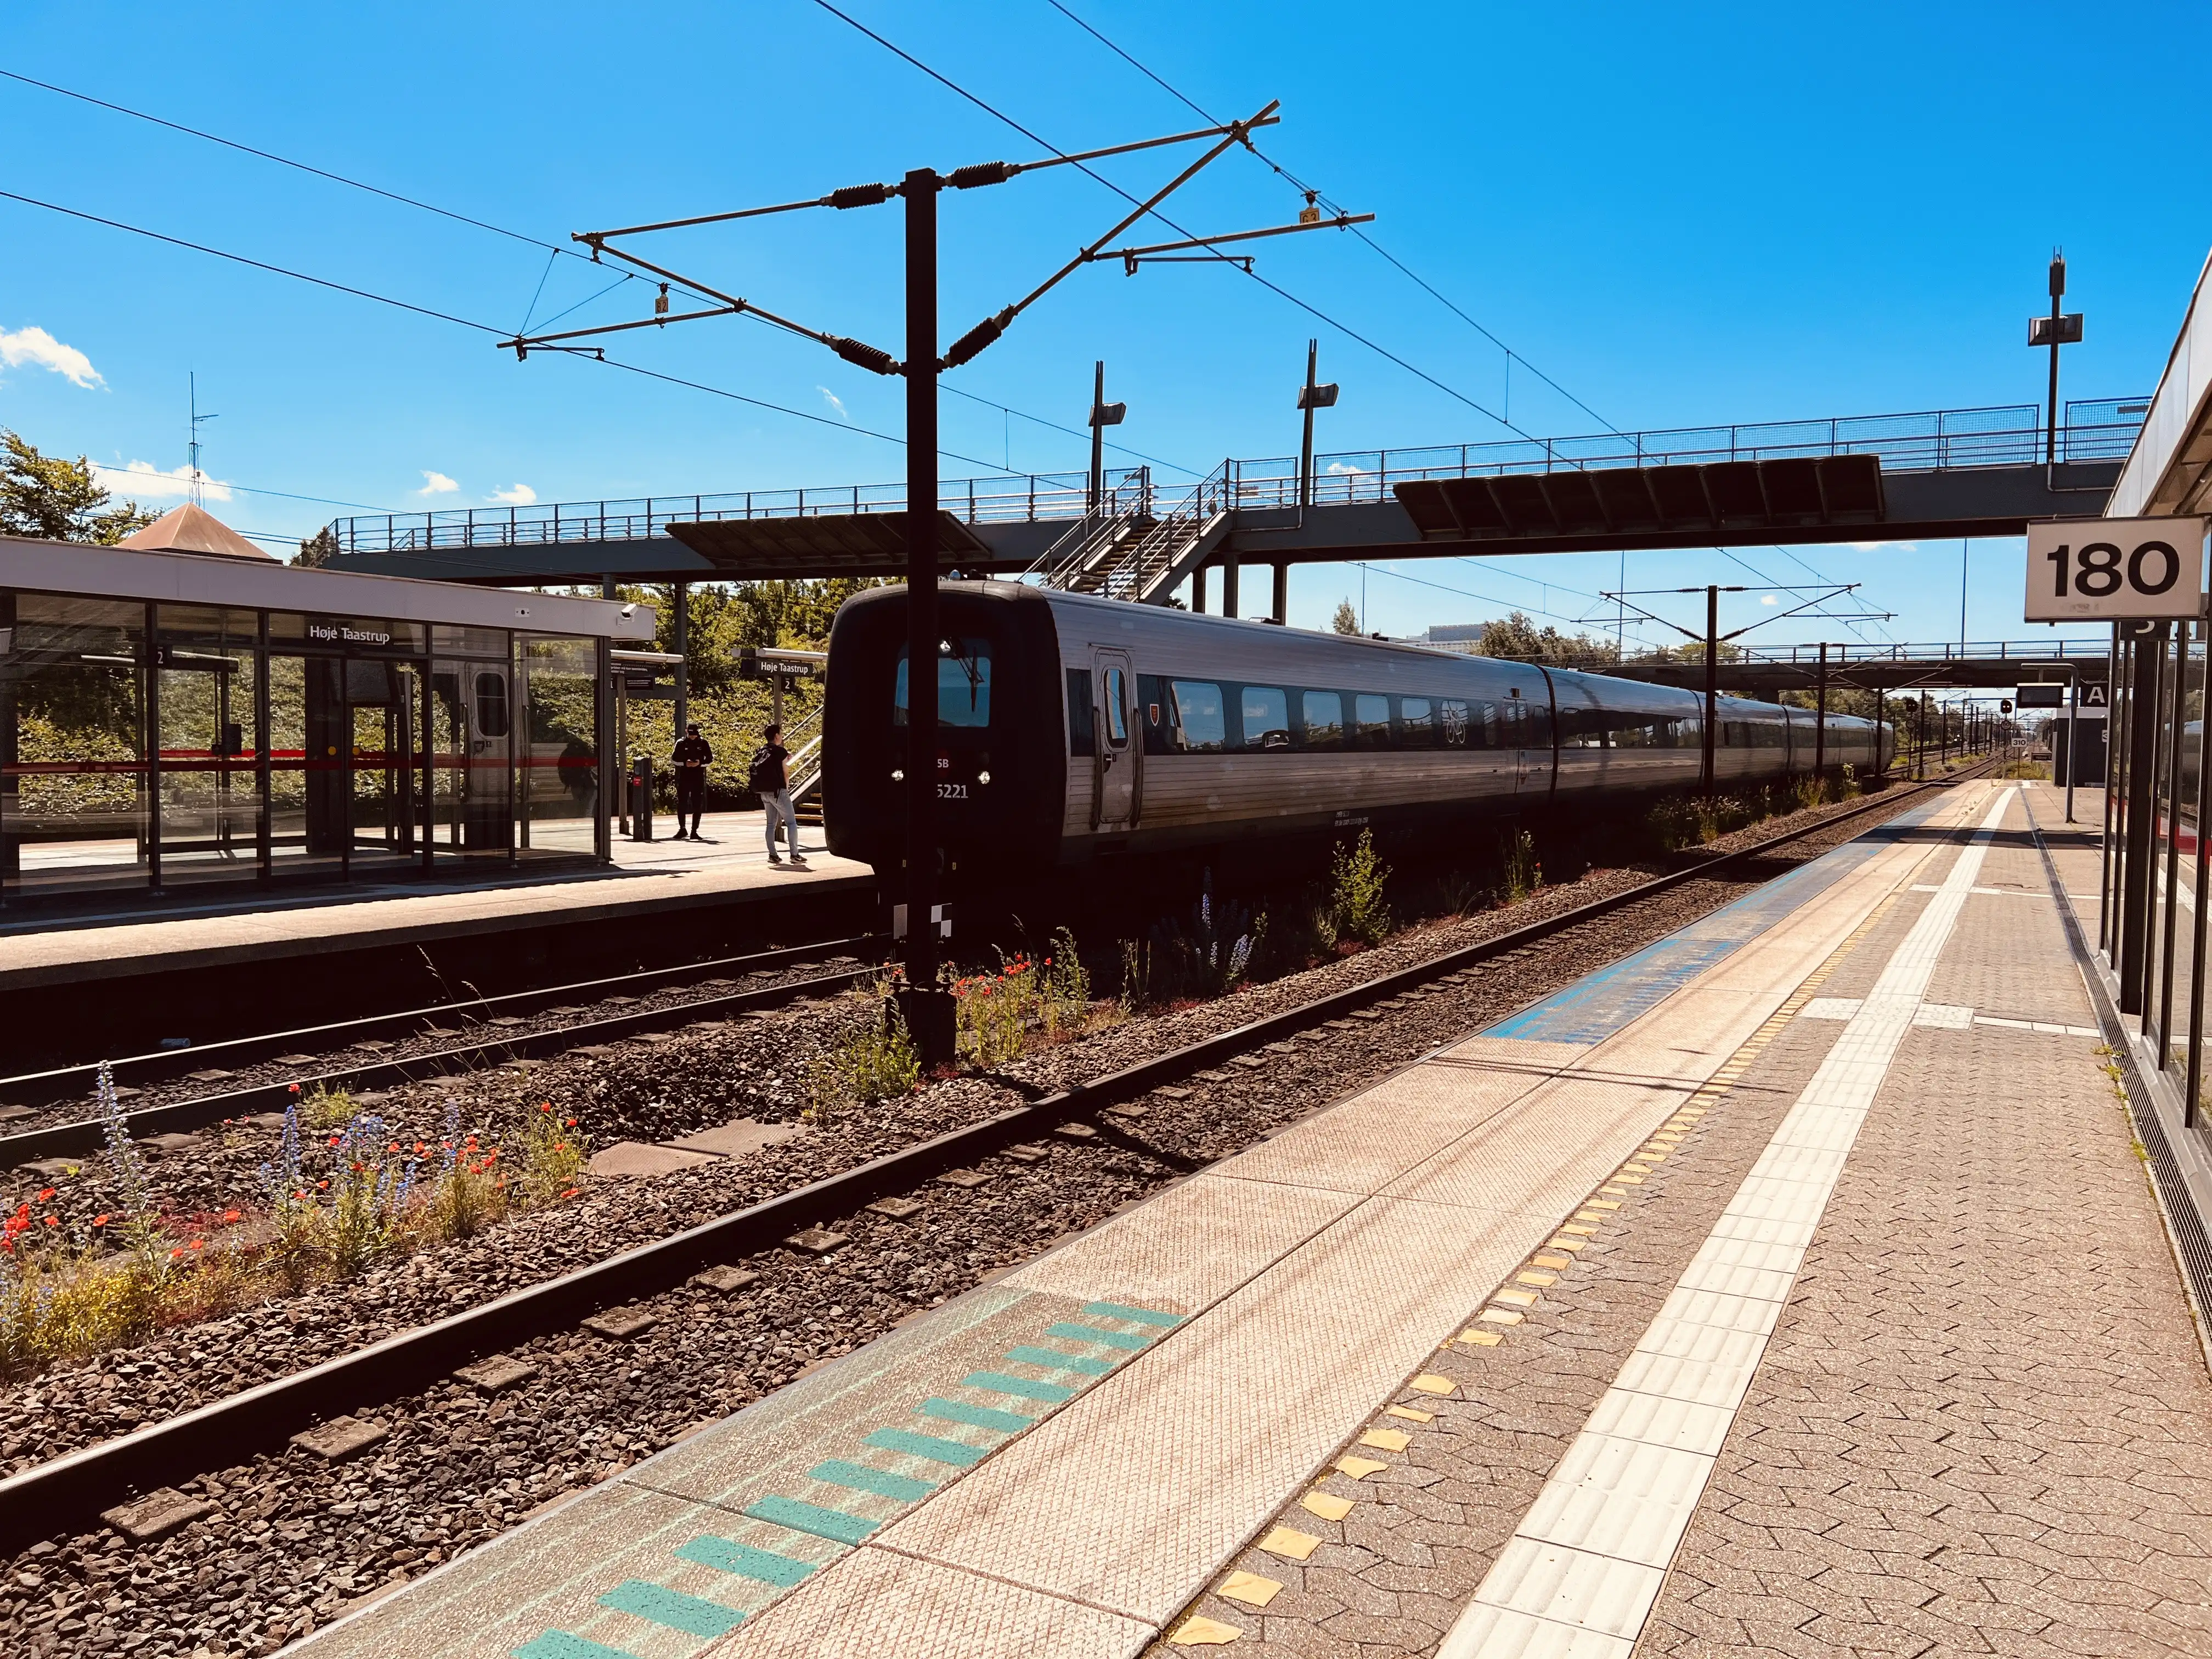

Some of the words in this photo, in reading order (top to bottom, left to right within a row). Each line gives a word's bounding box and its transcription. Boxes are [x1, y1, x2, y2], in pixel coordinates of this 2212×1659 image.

[657, 302, 667, 312] B2
[2047, 541, 2180, 597] 180
[310, 625, 337, 641] Høje
[341, 628, 390, 645] Taastrup
[157, 651, 163, 664] 2
[761, 661, 778, 673] Høje
[779, 663, 808, 675] Taastrup
[785, 681, 790, 689] 2
[2087, 687, 2106, 703] A
[937, 759, 949, 768] SB
[937, 784, 969, 798] 5221
